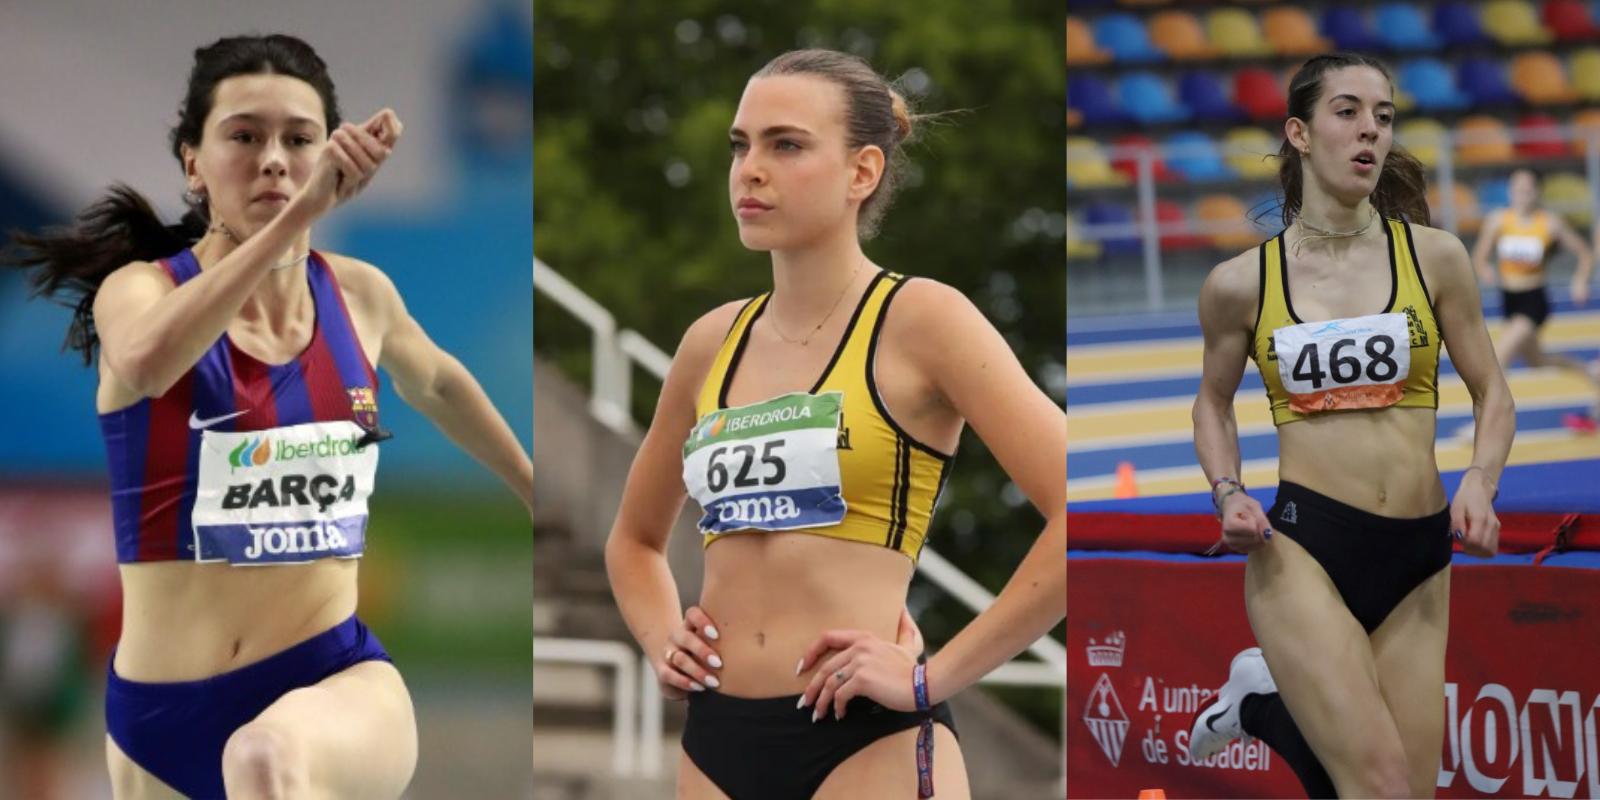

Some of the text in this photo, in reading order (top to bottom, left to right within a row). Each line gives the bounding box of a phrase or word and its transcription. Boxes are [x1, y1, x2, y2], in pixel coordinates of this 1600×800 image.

[1292, 334, 1399, 389] 468
[726, 405, 812, 433] IBERDROLA
[707, 439, 787, 493] 625
[222, 474, 356, 513] BARÇA
[1141, 728, 1169, 764] de
